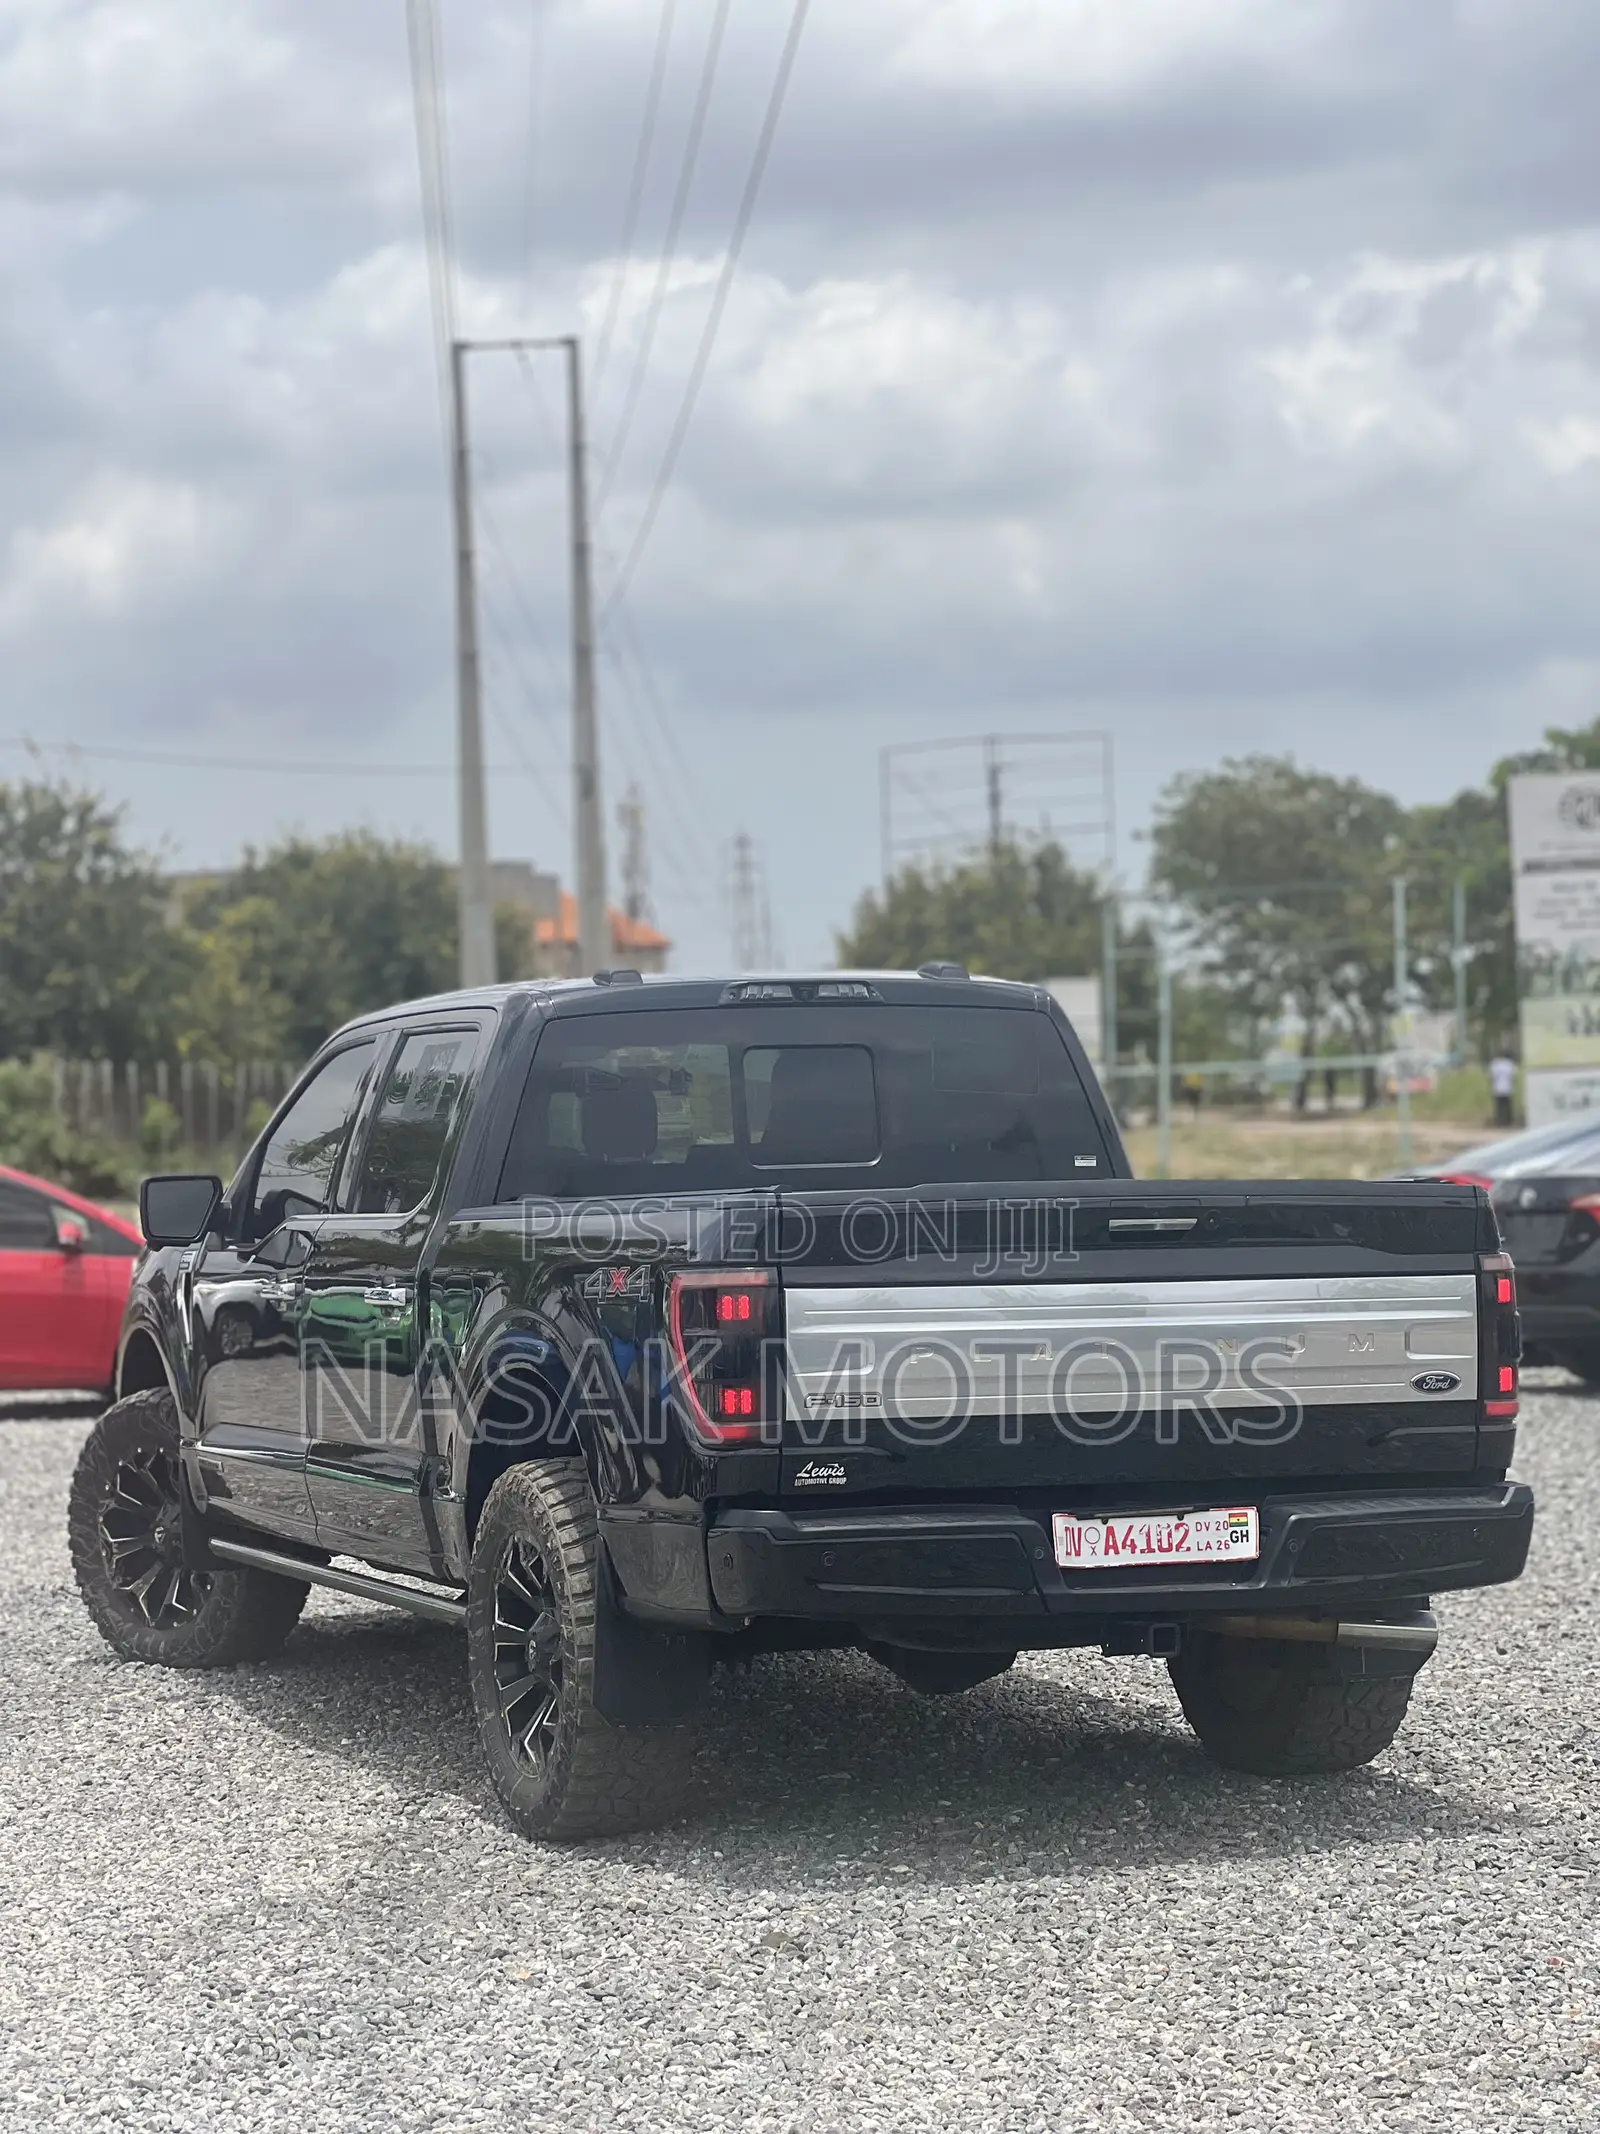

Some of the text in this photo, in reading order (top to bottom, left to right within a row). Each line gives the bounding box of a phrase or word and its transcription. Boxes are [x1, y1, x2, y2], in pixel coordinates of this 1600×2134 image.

[1422, 1375, 1451, 1389] Ford
[804, 1391, 882, 1409] F-150
[796, 1461, 846, 1477] Lewis
[828, 1477, 847, 1485] GROUP
[1195, 1520, 1229, 1532] DV 20
[1229, 1529, 1249, 1543] GH
[1196, 1539, 1230, 1551] LA 26
